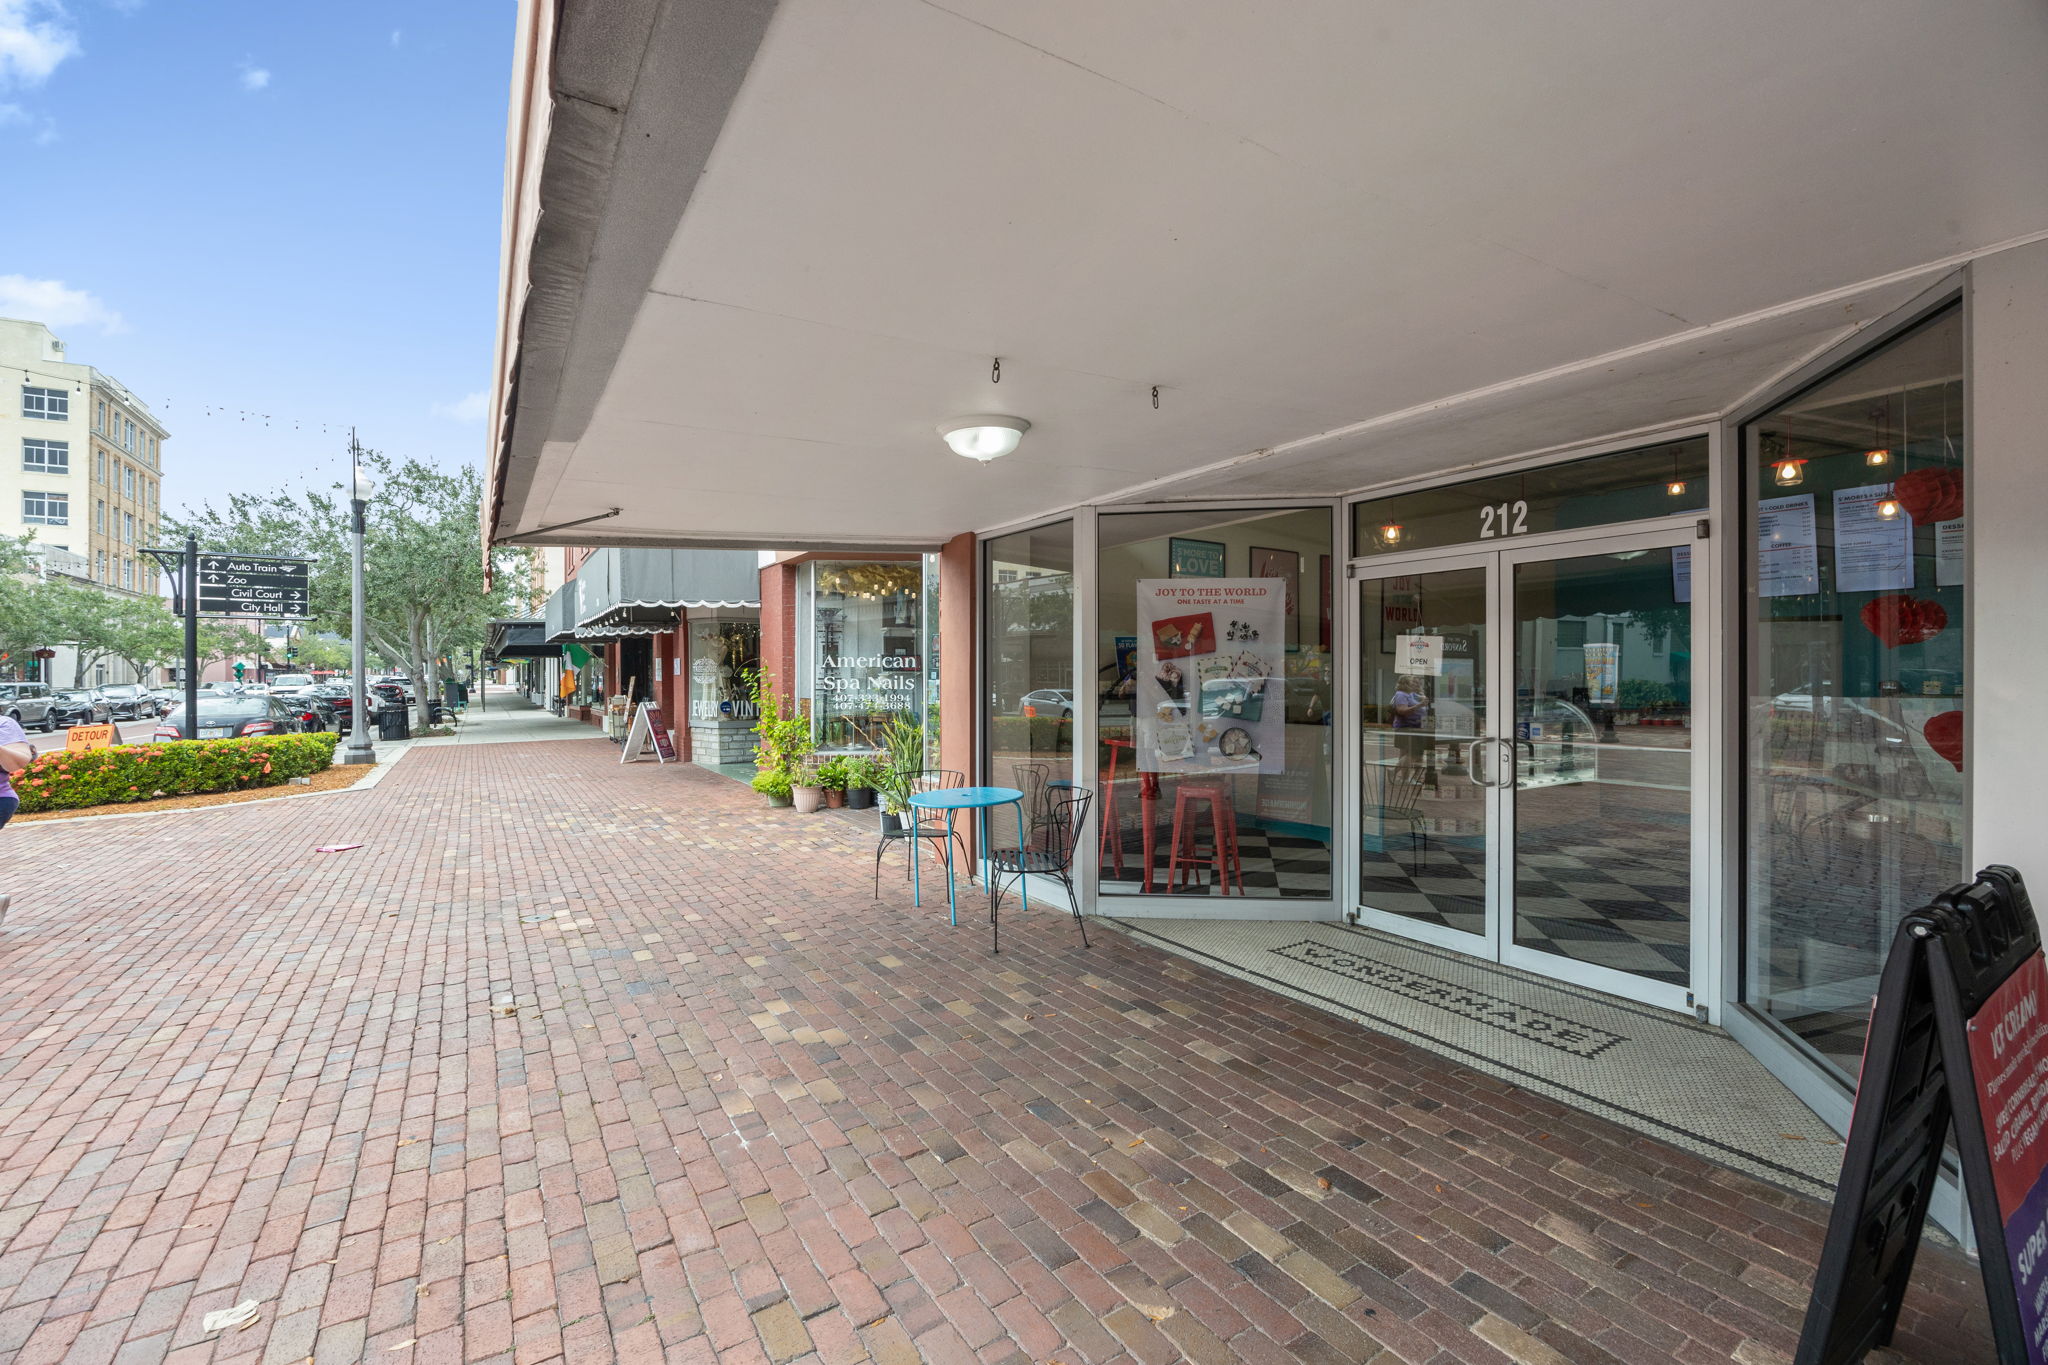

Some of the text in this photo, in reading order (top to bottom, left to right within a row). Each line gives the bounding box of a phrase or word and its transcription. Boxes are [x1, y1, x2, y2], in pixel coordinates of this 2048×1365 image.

[1480, 500, 1528, 538] 212
[1207, 551, 1219, 559] TO
[227, 562, 277, 572] Auto Train
[1178, 557, 1219, 575] LOVE
[227, 575, 247, 584] Zoo
[1392, 577, 1412, 591] JOY
[231, 588, 283, 599] Civil Court
[1155, 587, 1267, 597] JOY TO THE WORLD
[241, 602, 283, 612] City Hall
[821, 653, 916, 668] American
[823, 675, 915, 692] Spa Nails
[72, 729, 109, 742] DETOUR
[1304, 948, 1589, 1044] WONDERMADE
[2017, 1219, 2048, 1286] SUPER
